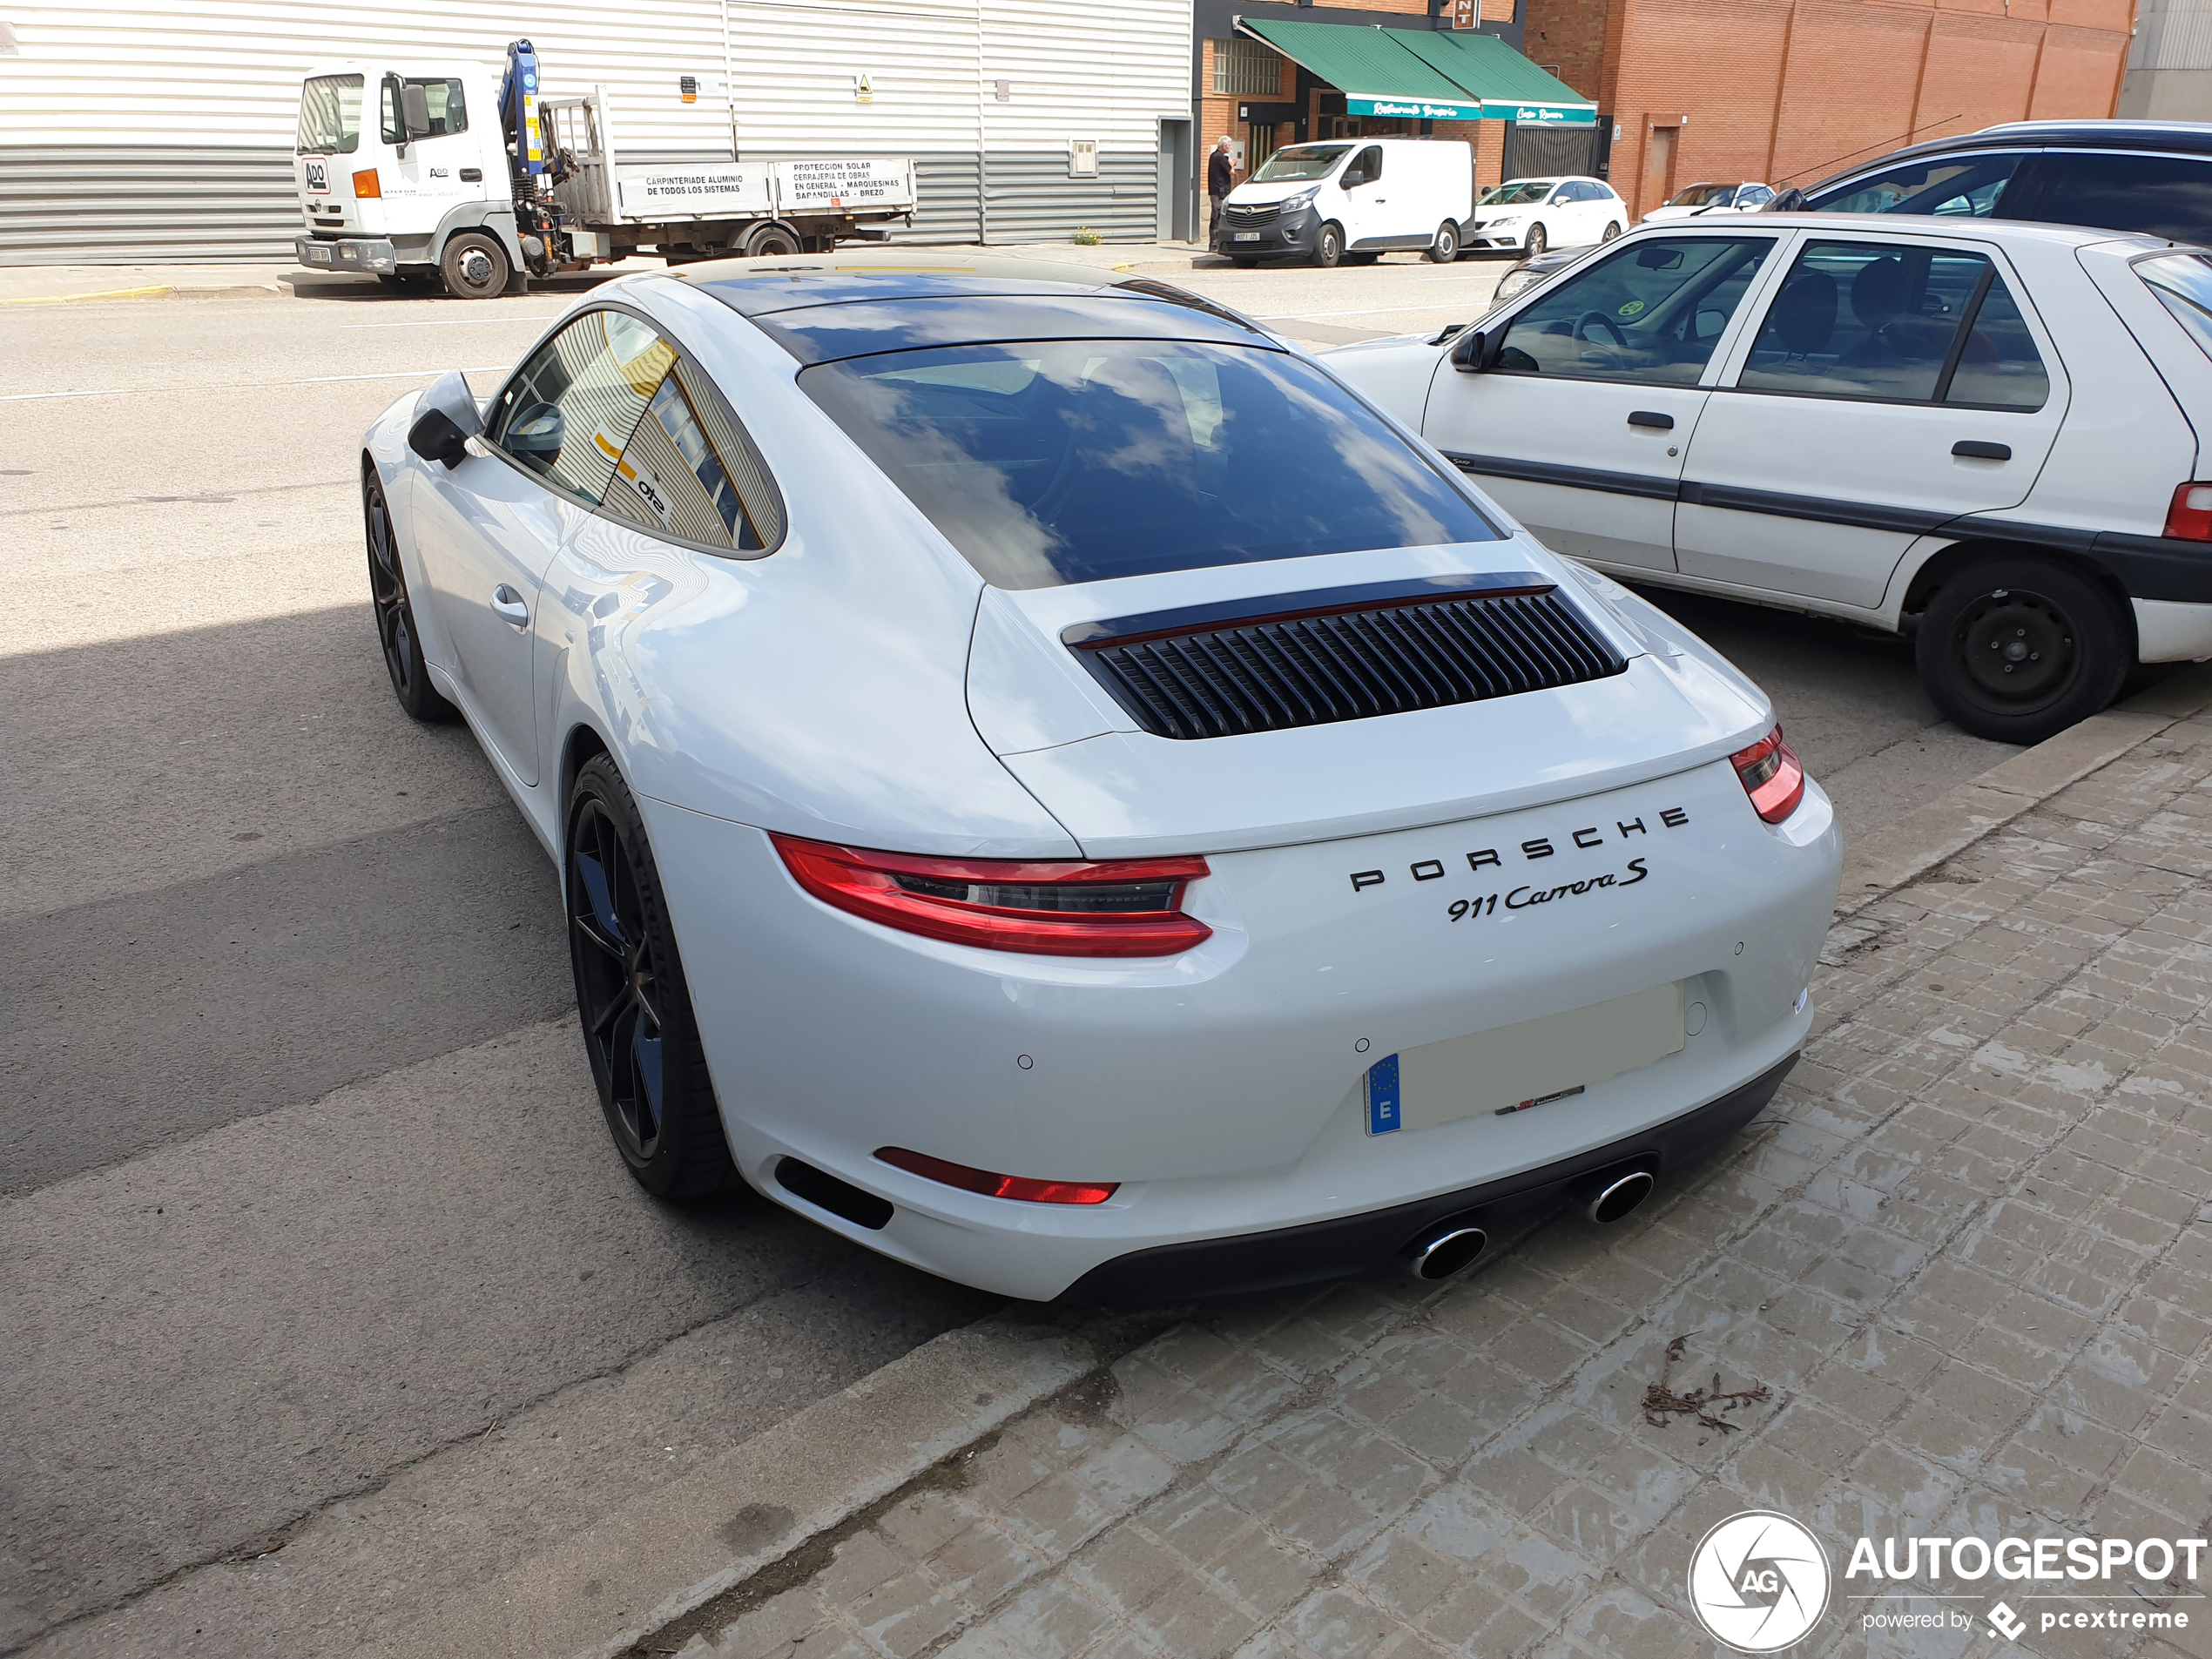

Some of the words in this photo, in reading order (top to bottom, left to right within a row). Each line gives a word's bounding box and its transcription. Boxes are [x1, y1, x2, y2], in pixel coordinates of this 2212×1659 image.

[1373, 102, 1420, 116] Restaurante
[1516, 107, 1537, 119] Casa
[793, 163, 843, 172] PROTECCION
[306, 162, 327, 189] ADO
[429, 168, 448, 179] ADO
[793, 172, 836, 181] CERRAJERIA
[708, 175, 743, 184] ALUMINIO
[846, 179, 900, 189] MARQUESINAS
[660, 186, 686, 195] TODOS
[688, 185, 702, 194] LOS
[704, 185, 740, 193] SISTEMAS
[796, 190, 850, 199] BARANDILLAS
[1349, 806, 1689, 893] PORSCHE
[1447, 894, 1498, 922] 911
[1505, 873, 1617, 910] Carrera
[1618, 857, 1649, 887] S
[1379, 1100, 1392, 1120] E
